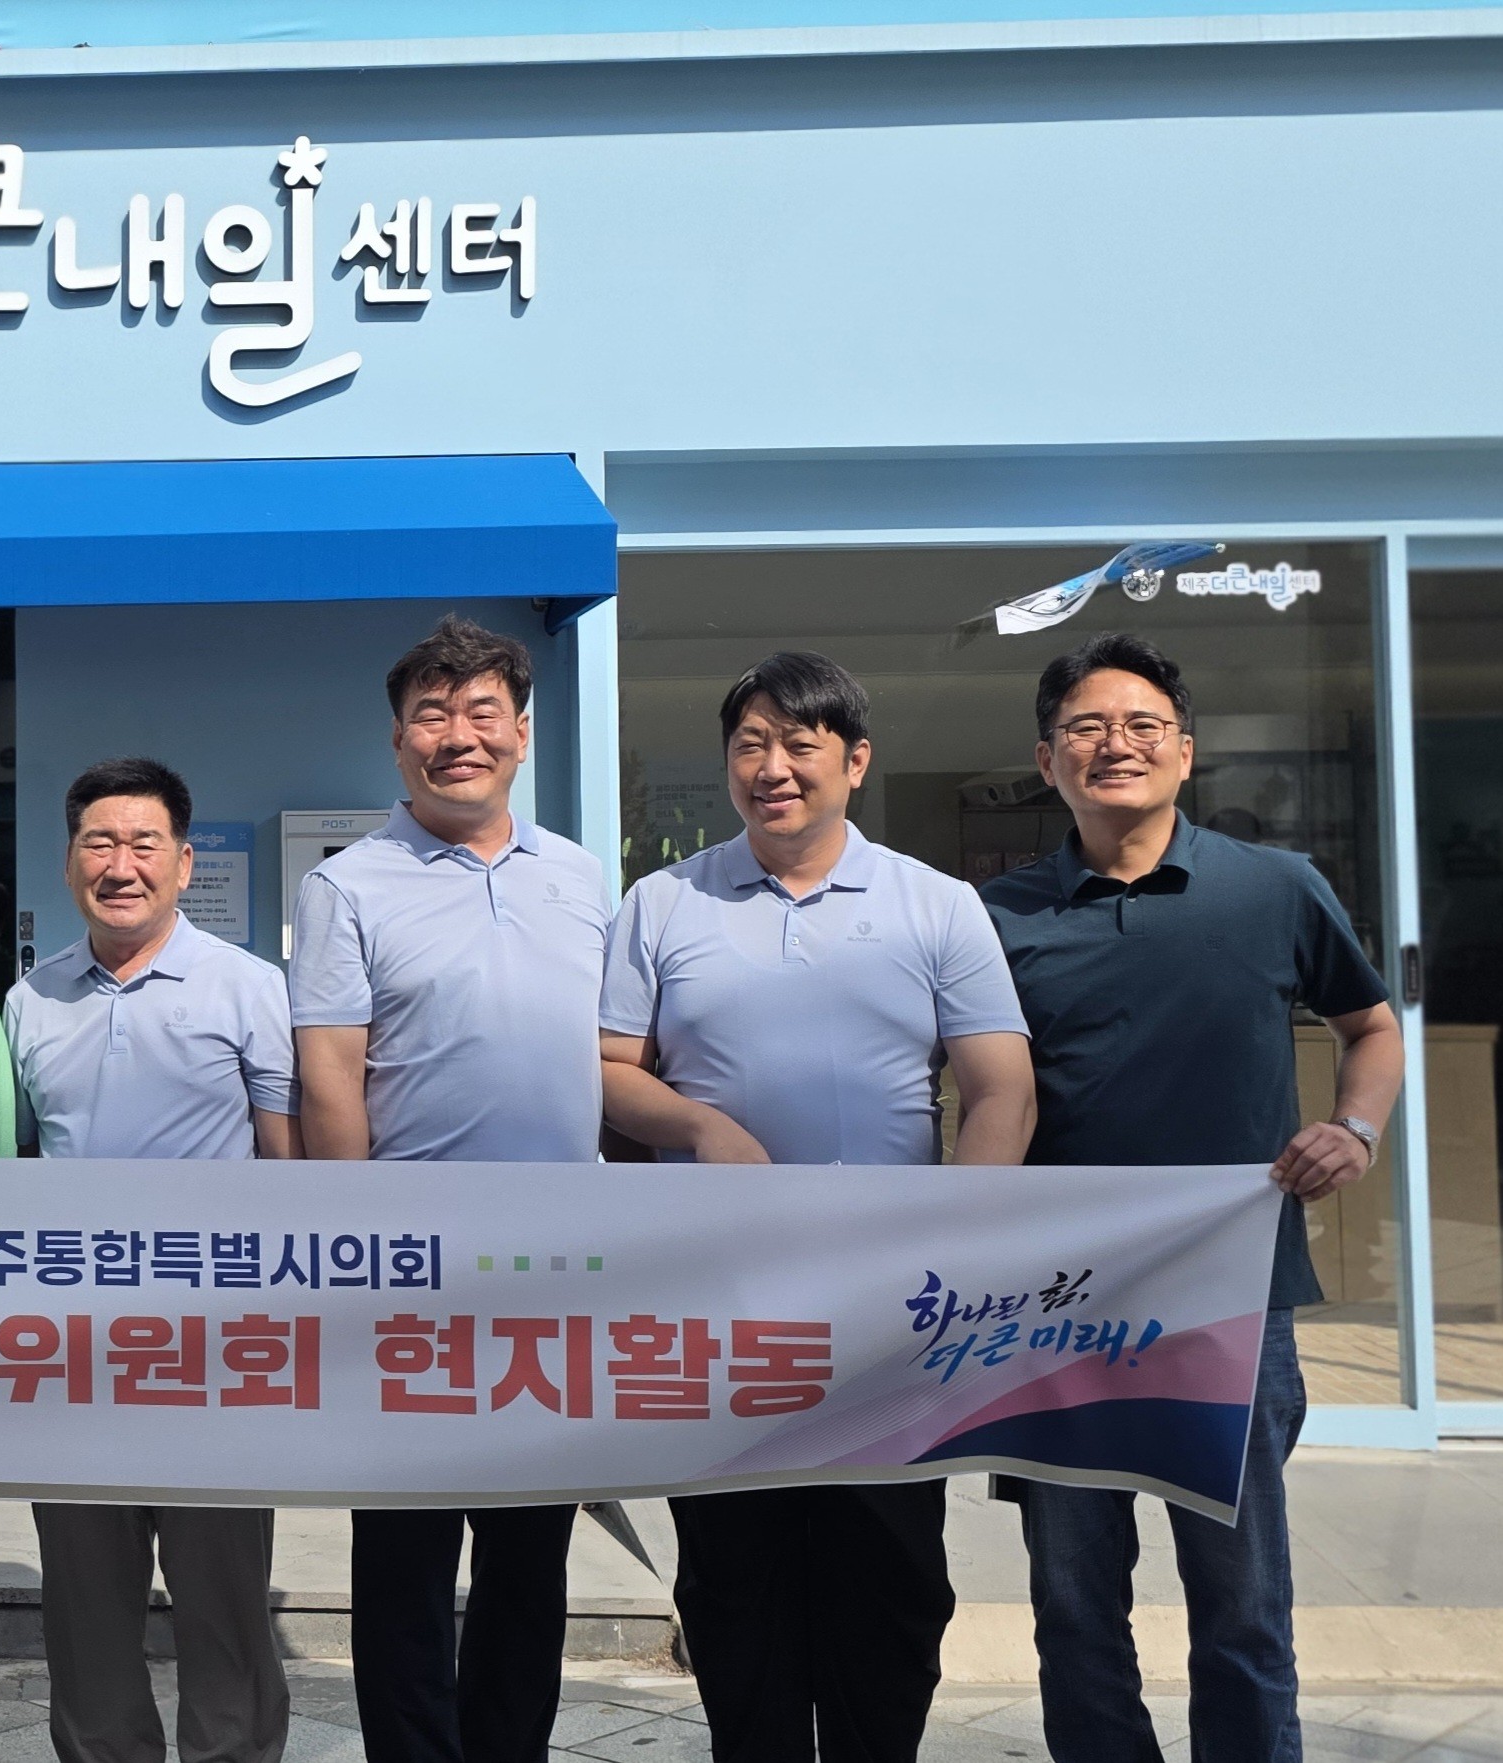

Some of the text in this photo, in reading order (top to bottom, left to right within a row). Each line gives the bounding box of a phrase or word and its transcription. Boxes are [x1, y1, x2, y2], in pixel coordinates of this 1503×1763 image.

[321, 820, 355, 829] POST
[905, 1269, 1030, 1367] 하나된
[1029, 1318, 1163, 1369] 미래!
[374, 1312, 834, 1420] 현지활동
